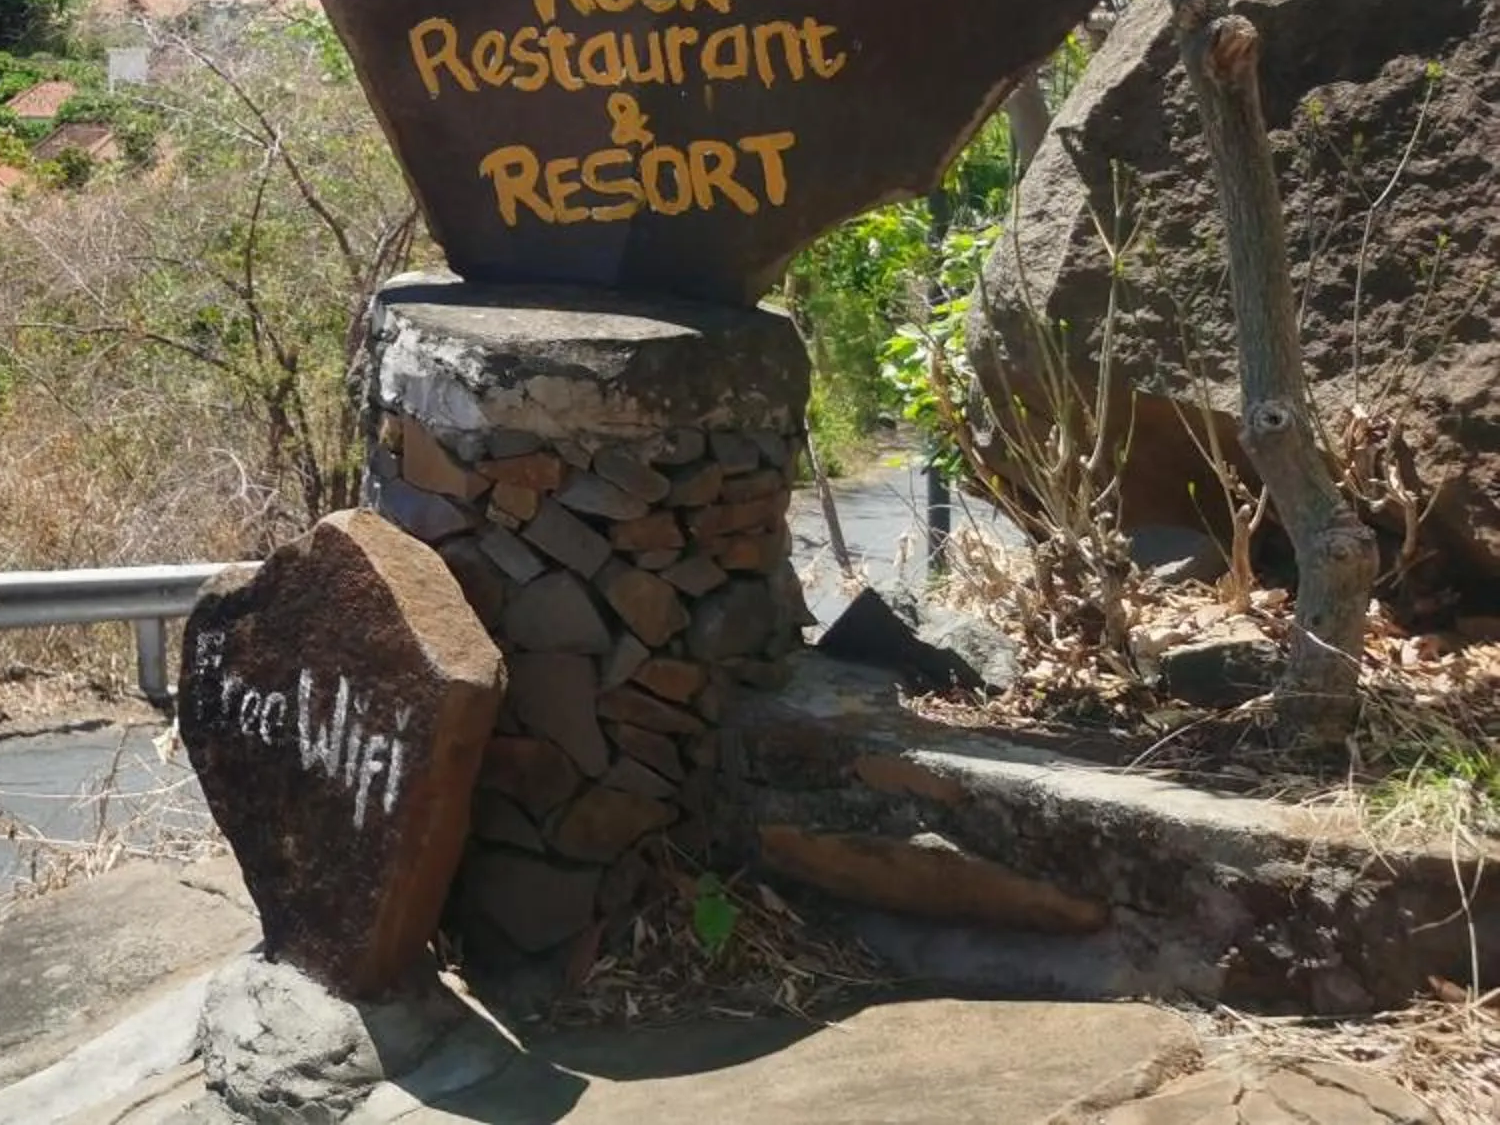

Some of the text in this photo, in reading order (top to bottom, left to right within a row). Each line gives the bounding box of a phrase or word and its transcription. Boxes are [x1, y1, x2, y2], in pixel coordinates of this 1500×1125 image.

[409, 18, 844, 98] Restaurant
[607, 93, 651, 146] &
[479, 132, 795, 226] RESORT
